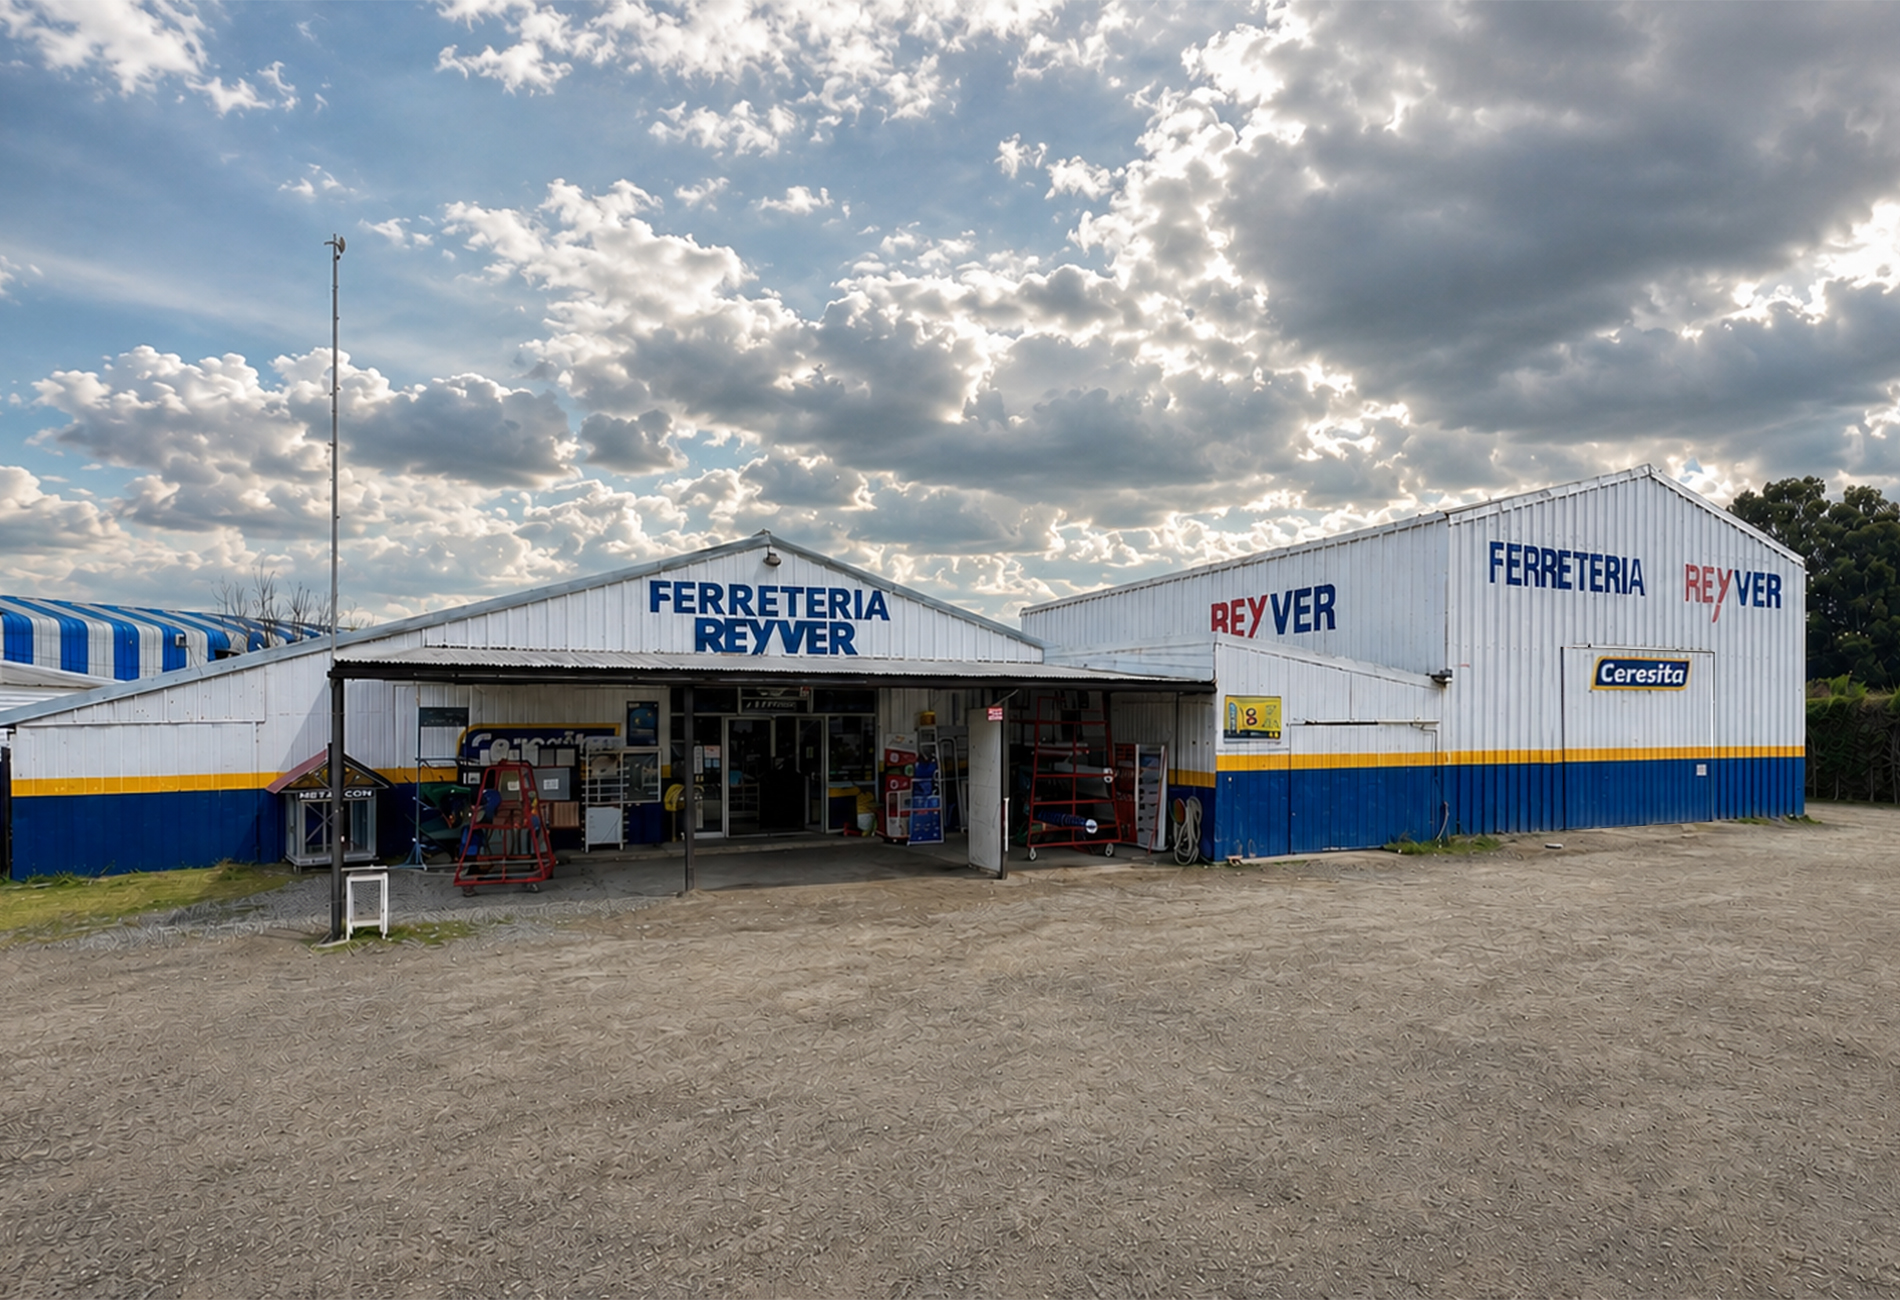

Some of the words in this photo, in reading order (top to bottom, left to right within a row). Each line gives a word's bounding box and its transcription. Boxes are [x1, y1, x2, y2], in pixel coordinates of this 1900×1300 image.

[1489, 541, 1645, 596] FERRETERIA
[649, 580, 890, 621] FERRETERIA
[1211, 583, 1336, 639] REYVER
[1684, 563, 1782, 623] REYVER
[694, 617, 859, 656] REYVER
[1600, 663, 1685, 684] Ceresita
